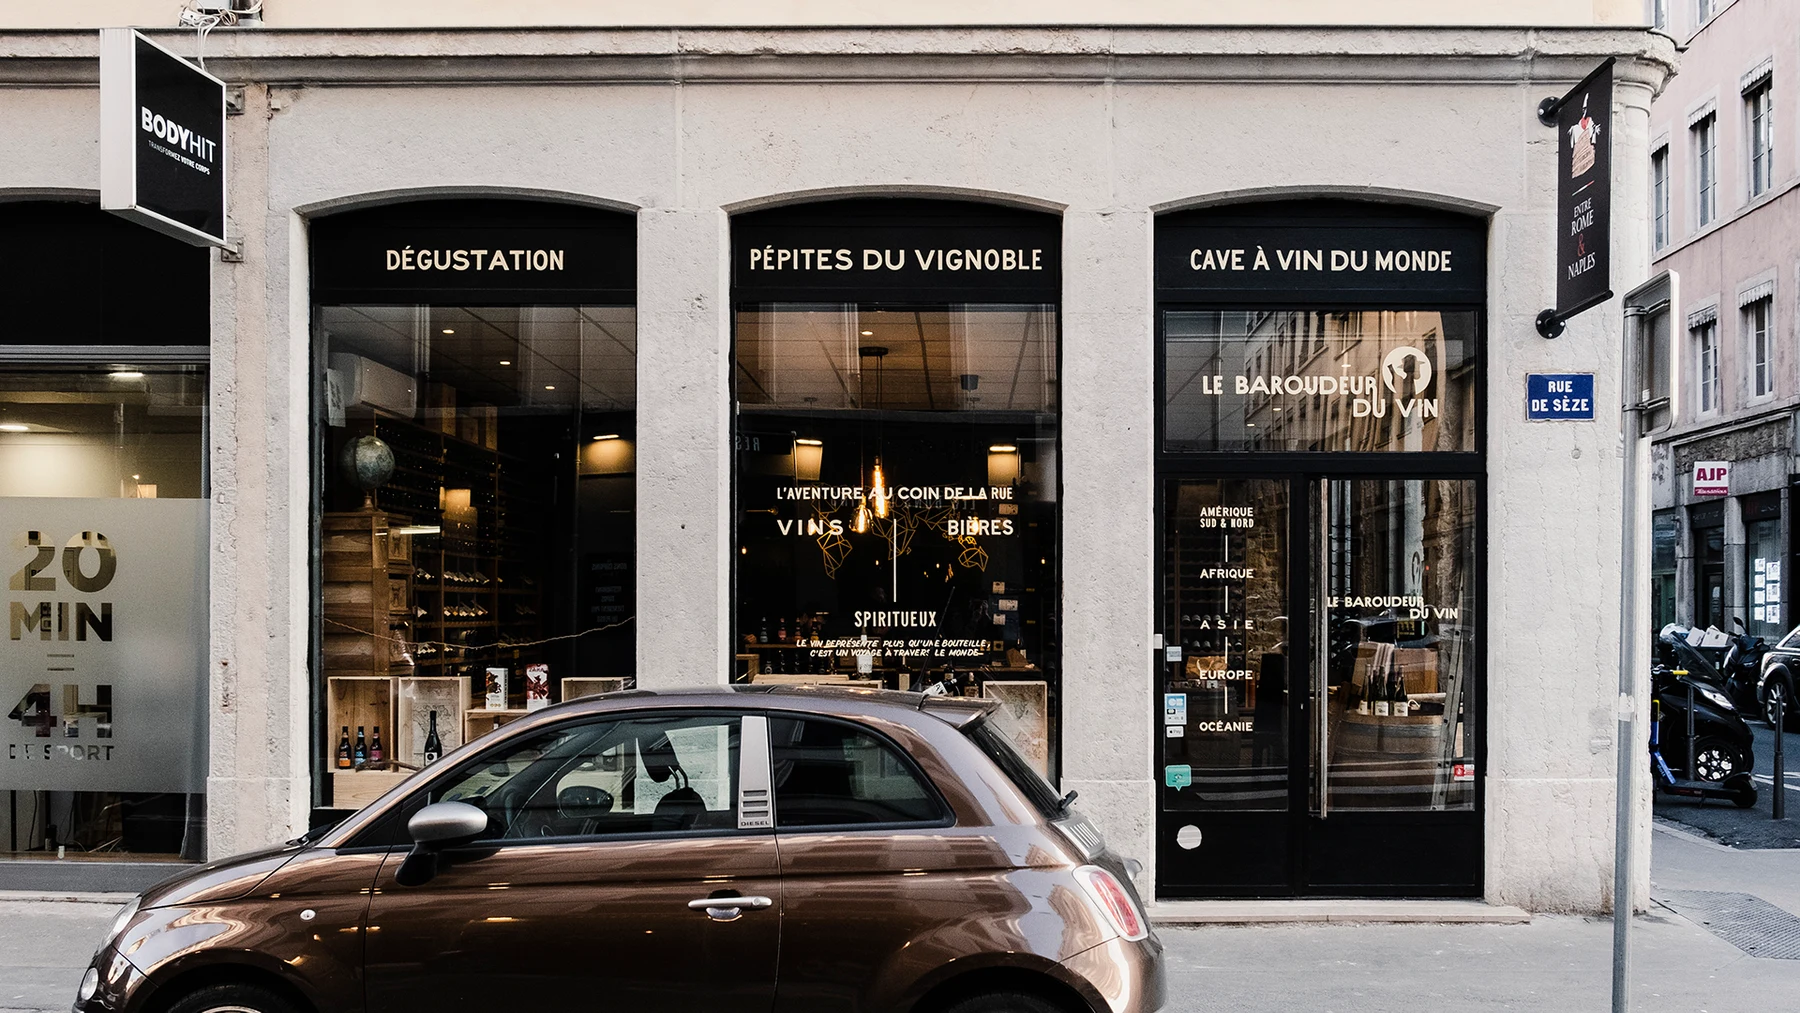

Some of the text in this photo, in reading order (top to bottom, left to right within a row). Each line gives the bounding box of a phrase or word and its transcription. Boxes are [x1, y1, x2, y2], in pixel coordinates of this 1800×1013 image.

[142, 106, 216, 163] BODYHIT
[148, 140, 210, 175] TRANSFORMEZ VOTRE CORPS
[1574, 197, 1592, 218] ENTRE
[1571, 209, 1594, 236] ROME
[1577, 233, 1585, 257] &
[386, 246, 564, 271] DÉGUSTATION
[750, 245, 1043, 271] PÉPITES DU VIGNOBLE
[1190, 246, 1452, 272] CAVE À VIN DU MONDE
[1568, 252, 1595, 280] NAPLES
[1202, 375, 1378, 396] LE BAROUDEUR
[1548, 380, 1573, 393] RUE
[1352, 398, 1439, 419] DU VIN
[1531, 395, 1590, 412] DE SÈZE
[1695, 467, 1728, 481] AJP
[776, 487, 1013, 500] L'AVENTURE AU COIN DE LA RUE
[1200, 506, 1254, 517] AMÉRIQUE
[776, 518, 843, 536] VINS
[947, 515, 1014, 536] BIÈRES
[1200, 518, 1254, 529] SUD & NORD
[9, 530, 117, 593] 20
[1199, 568, 1254, 579] AFRIQUE
[1327, 596, 1424, 608] LE BAROUDEUR
[9, 601, 113, 642] MIN
[854, 610, 937, 628] SPIRITUEUX
[1409, 607, 1459, 619] DU VIN
[1199, 619, 1254, 630] ASIE
[796, 639, 807, 648] LE
[810, 639, 823, 648] VIN
[824, 637, 880, 649] REPRÉSENTE
[882, 640, 904, 648] PLUS
[941, 639, 991, 649] BOUTEILLE,
[809, 649, 833, 658] C'EST
[835, 649, 849, 657] UN
[850, 649, 882, 657] VOYAGE
[884, 647, 893, 657] À
[934, 649, 945, 657] LE
[1199, 669, 1253, 680] EUROPE
[8, 683, 113, 738] 4H
[1199, 720, 1253, 732] OCÉANIE
